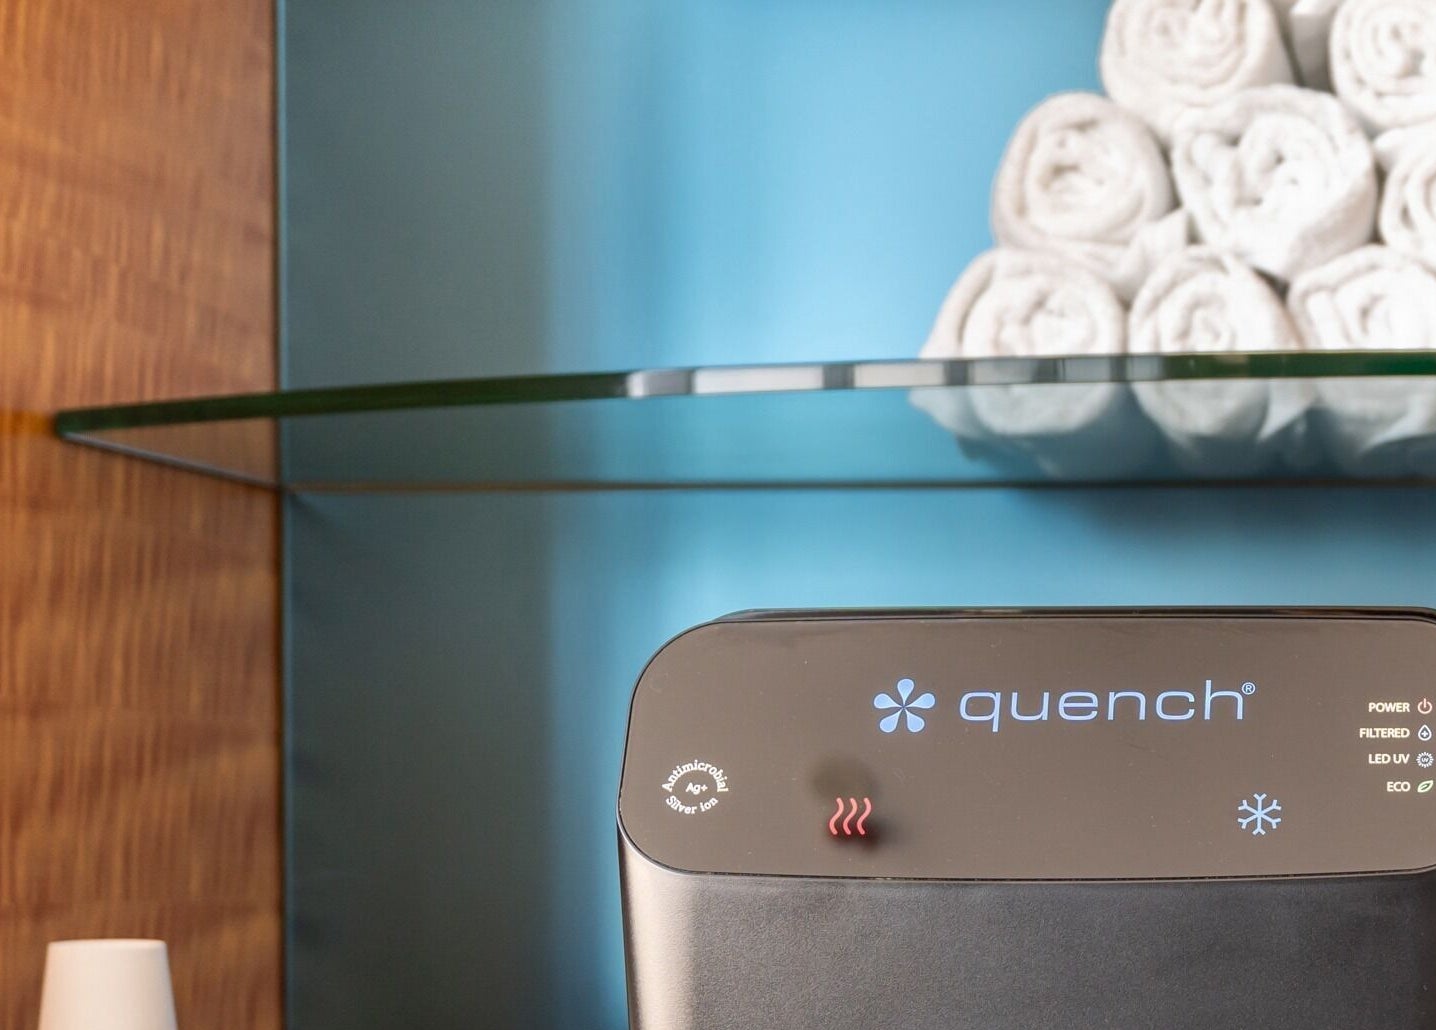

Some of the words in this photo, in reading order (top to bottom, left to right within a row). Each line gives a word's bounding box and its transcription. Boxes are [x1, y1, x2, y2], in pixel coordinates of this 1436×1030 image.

[1368, 702, 1411, 713] POWER
[1359, 727, 1411, 738] FILTERED
[1368, 753, 1391, 764] LED
[1393, 753, 1410, 764] UV
[661, 759, 729, 792] Antimicrobial
[685, 782, 708, 795] Ag+
[1386, 781, 1411, 792] ECO
[665, 795, 698, 814] Silver
